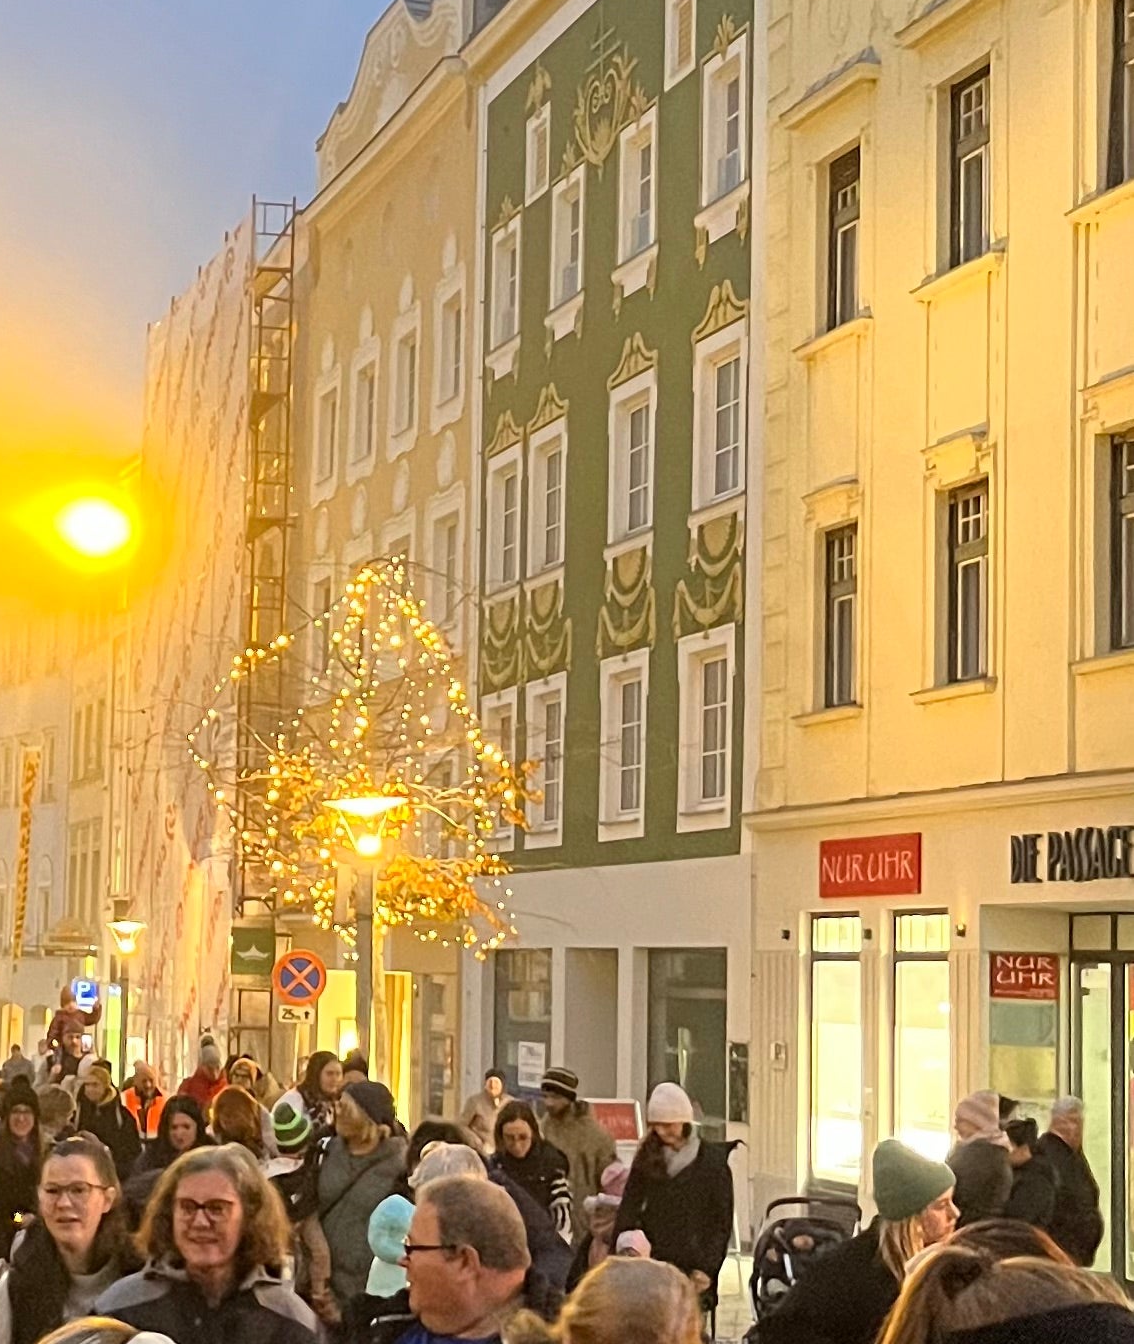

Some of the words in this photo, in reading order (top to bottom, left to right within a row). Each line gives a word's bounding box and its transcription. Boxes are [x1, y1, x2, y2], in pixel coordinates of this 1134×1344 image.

[822, 854, 864, 883] NUR
[867, 851, 914, 882] UHR
[1010, 834, 1043, 883] DIE
[996, 955, 1053, 969] NUR
[997, 971, 1054, 985] UHR
[77, 981, 91, 998] P
